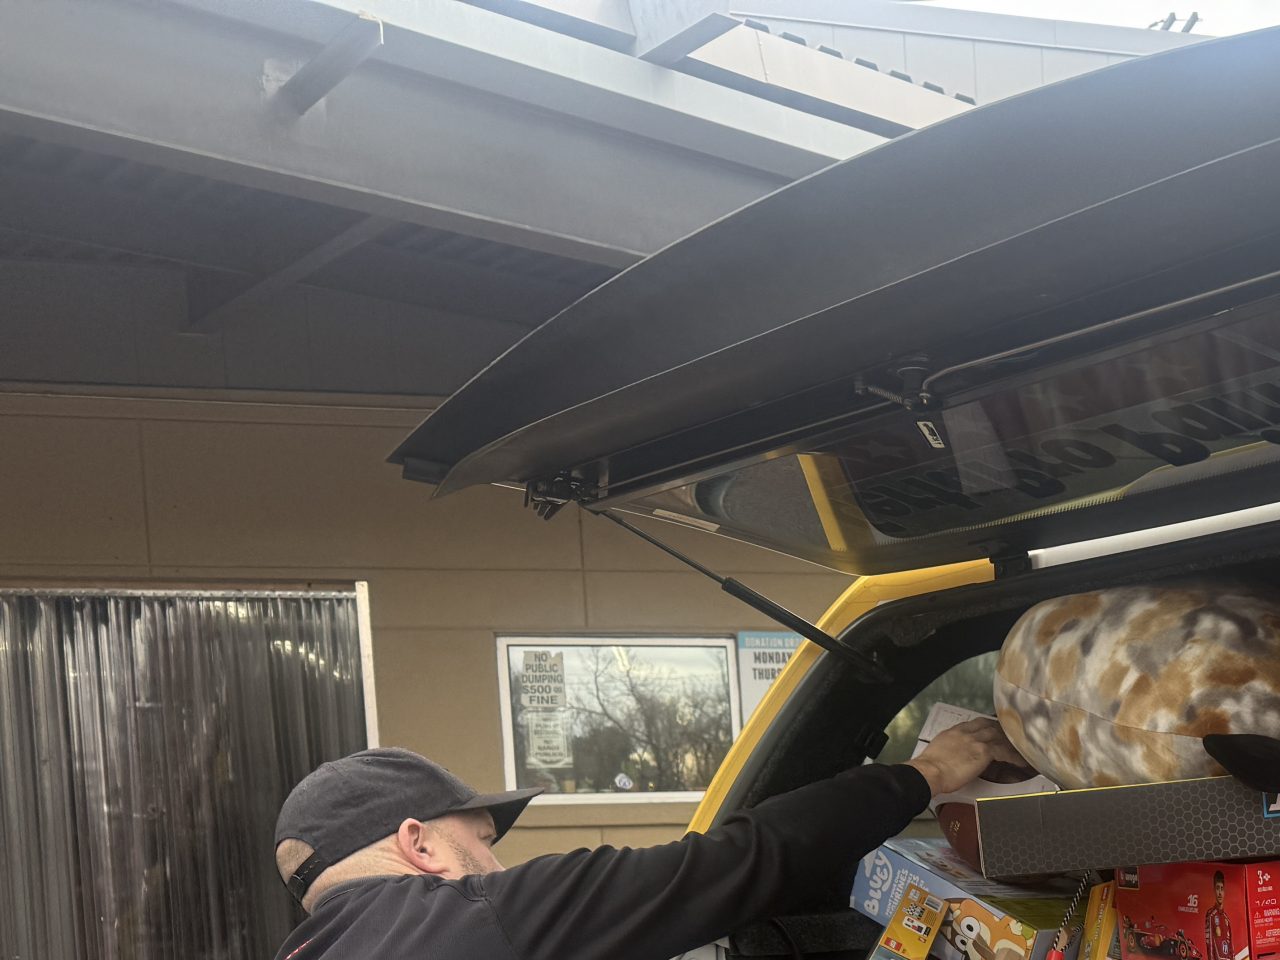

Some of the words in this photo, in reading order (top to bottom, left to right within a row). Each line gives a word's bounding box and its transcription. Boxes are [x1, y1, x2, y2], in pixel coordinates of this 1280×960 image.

[535, 653, 548, 662] NO
[525, 663, 559, 673] PUBLIC
[521, 674, 564, 684] DUMPING
[522, 685, 552, 694] $500
[529, 695, 559, 705] FINE
[864, 850, 893, 916] BLUEY
[1187, 894, 1199, 907] 16
